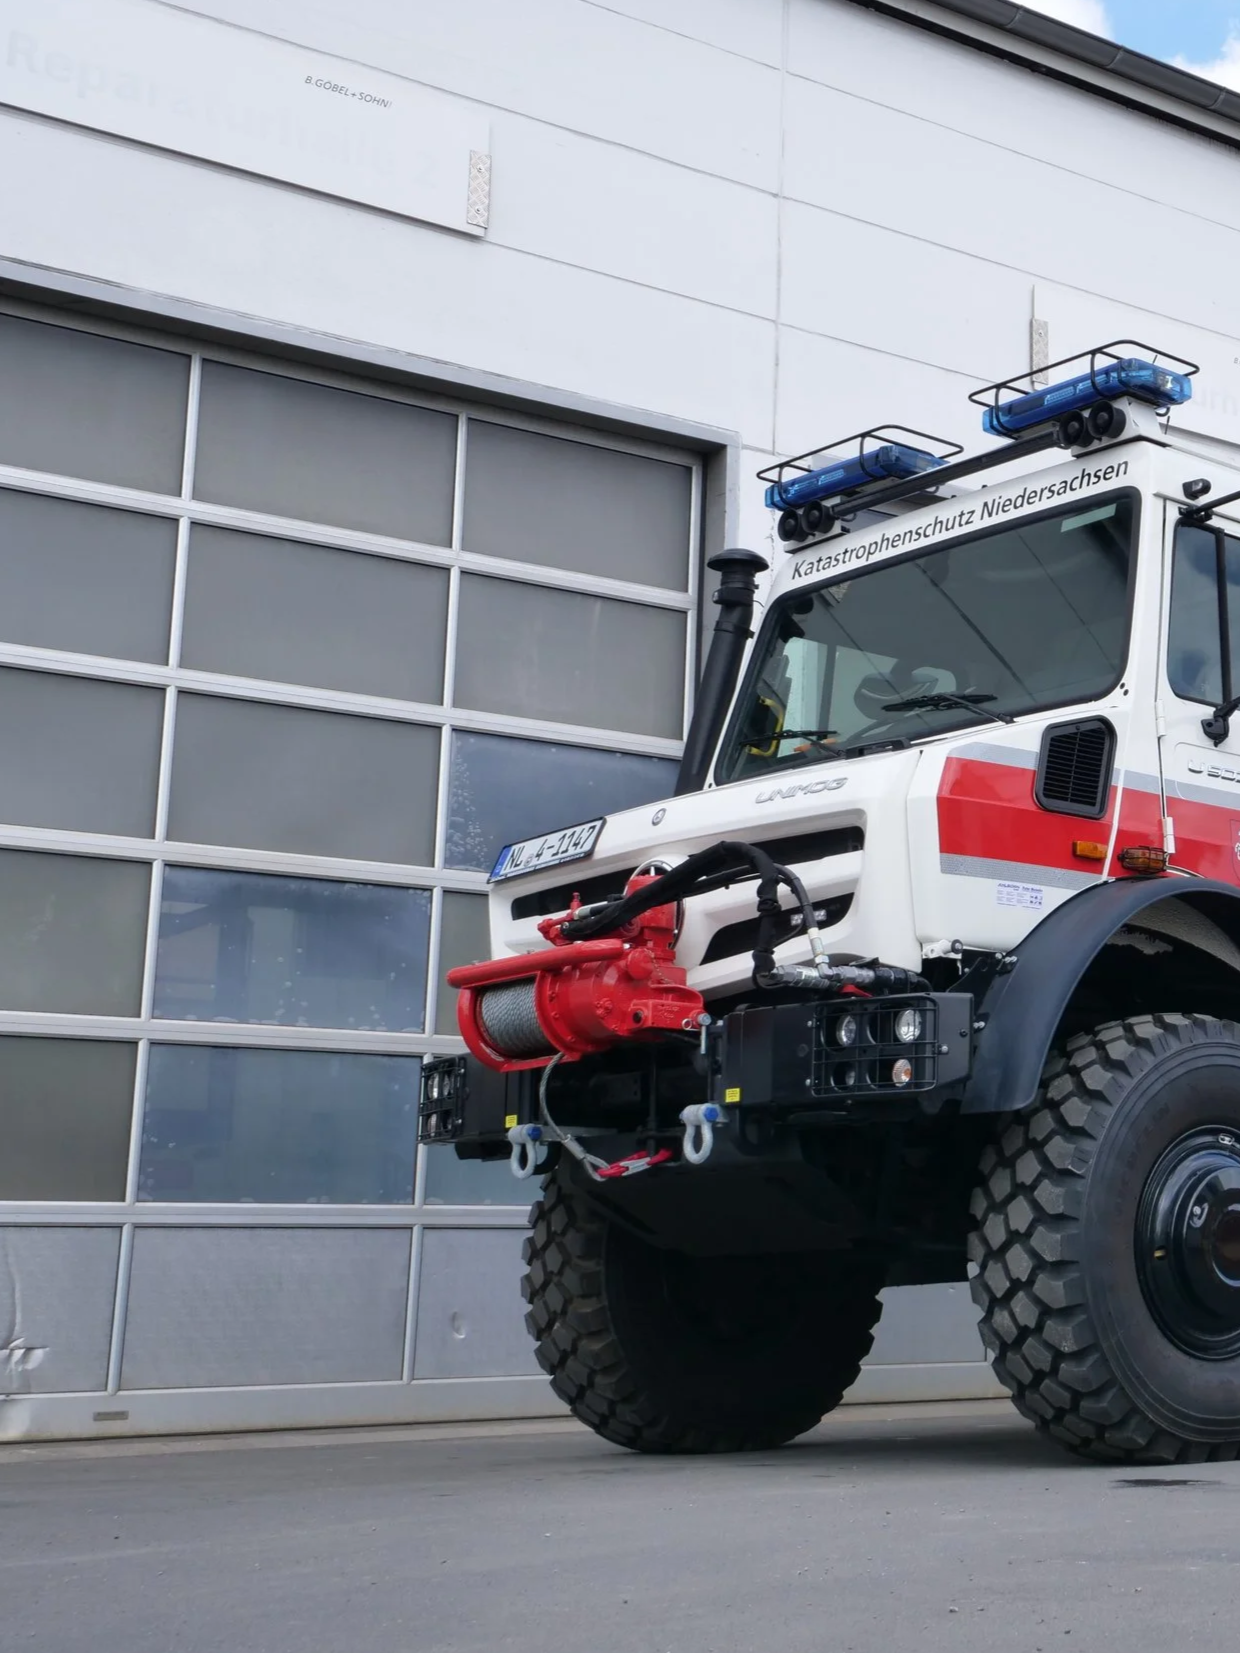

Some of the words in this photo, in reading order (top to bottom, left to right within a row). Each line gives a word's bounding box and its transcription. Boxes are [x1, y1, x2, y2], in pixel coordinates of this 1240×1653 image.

[791, 509, 976, 580] Katastrophenschutz
[980, 459, 1129, 522] Niedersachsen
[1187, 759, 1205, 774] U
[755, 777, 848, 804] UNIMOG
[503, 845, 526, 871] NL
